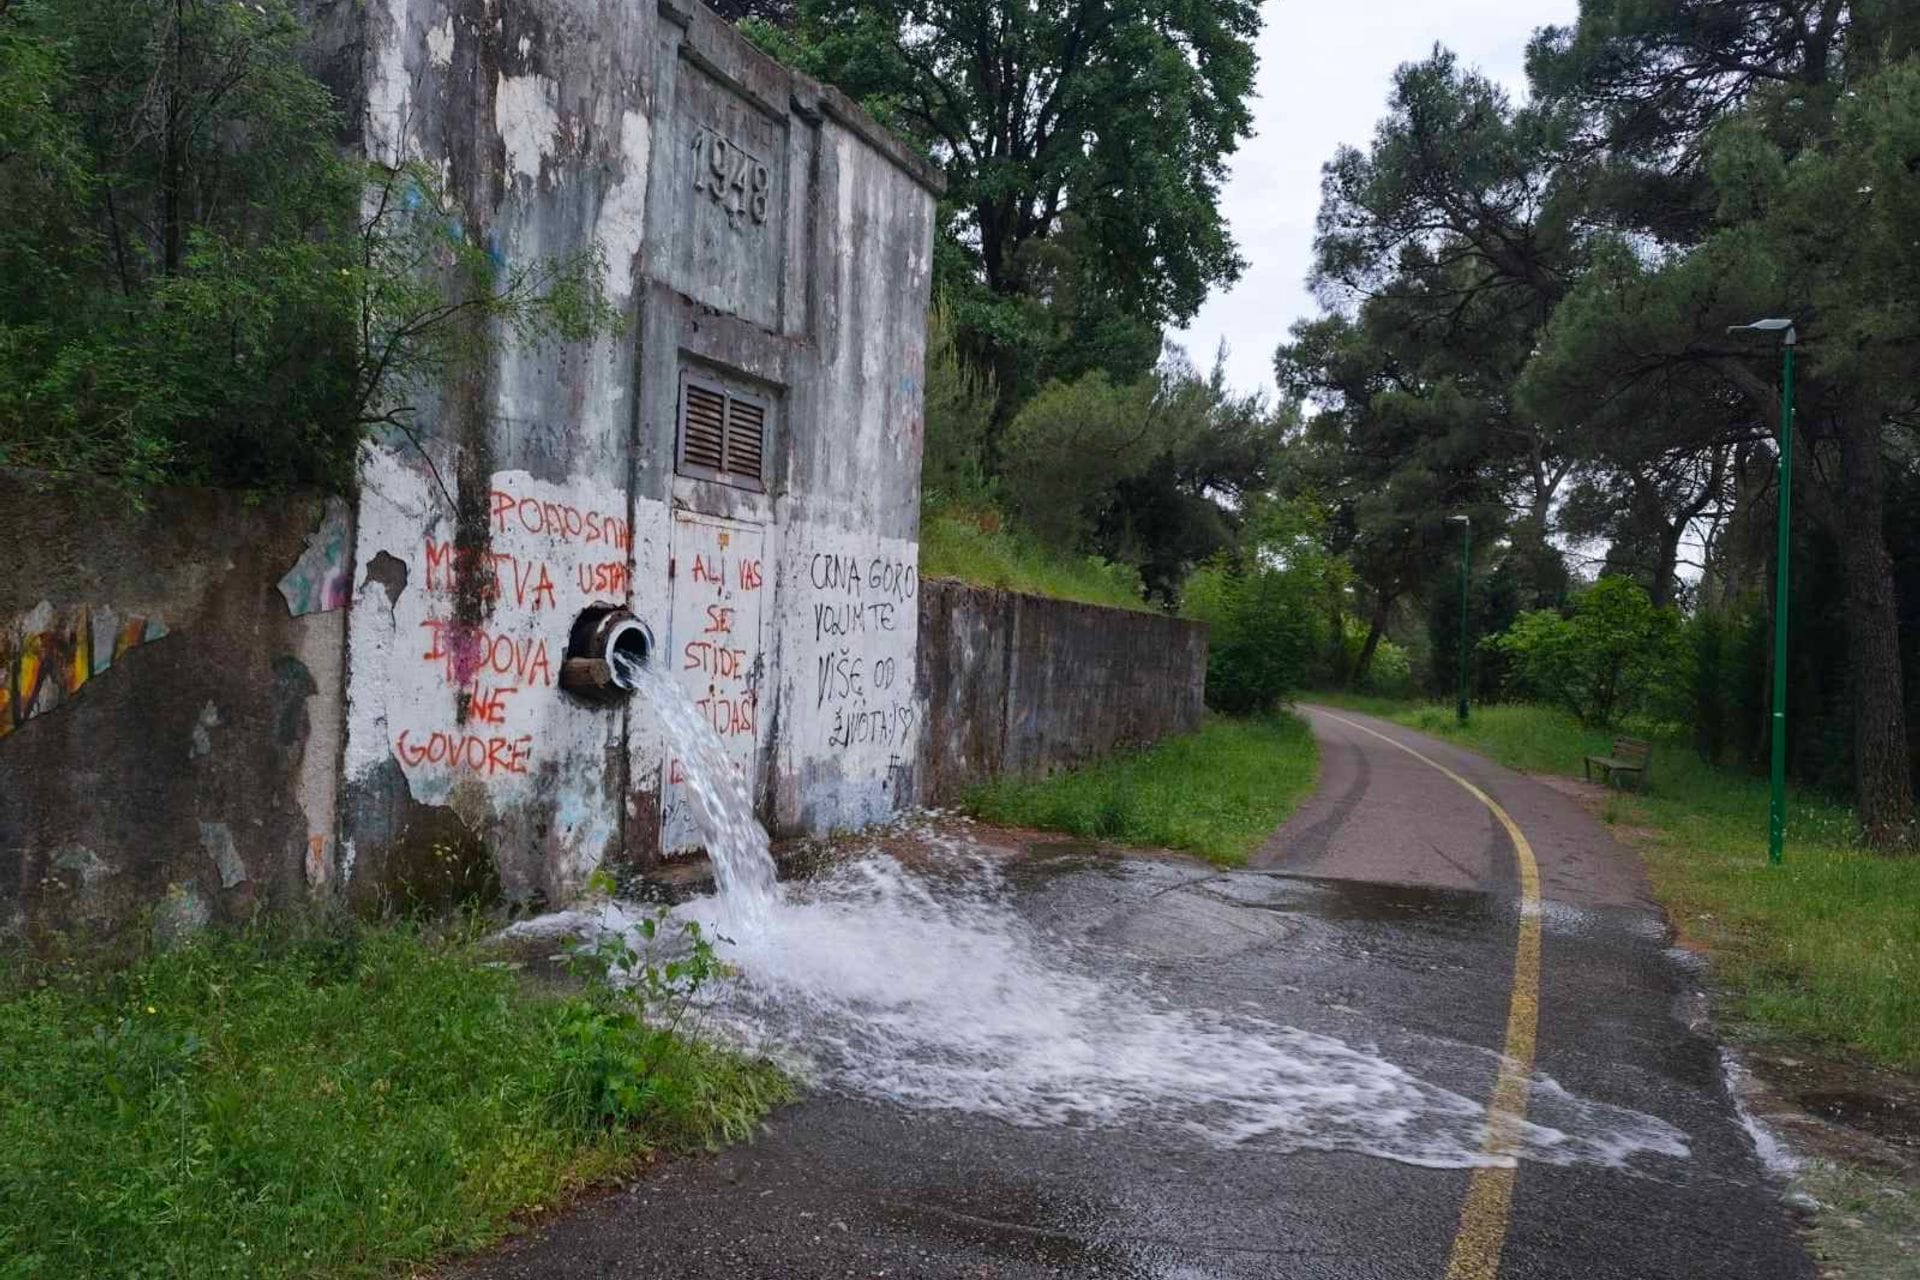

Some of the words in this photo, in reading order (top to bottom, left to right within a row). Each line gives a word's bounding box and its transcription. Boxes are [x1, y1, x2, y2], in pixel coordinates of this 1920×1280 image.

[690, 129, 769, 226] 1948
[691, 554, 726, 586] ALI
[738, 558, 763, 591] VAS
[810, 553, 862, 597] CRNA
[869, 558, 915, 605] GORO
[704, 606, 736, 633] SE
[868, 604, 895, 632] TE
[684, 640, 746, 681] STIDE
[817, 648, 864, 710] VIŠE
[873, 657, 895, 689] OD
[470, 682, 518, 723] NE
[396, 729, 533, 775] GOVORE
